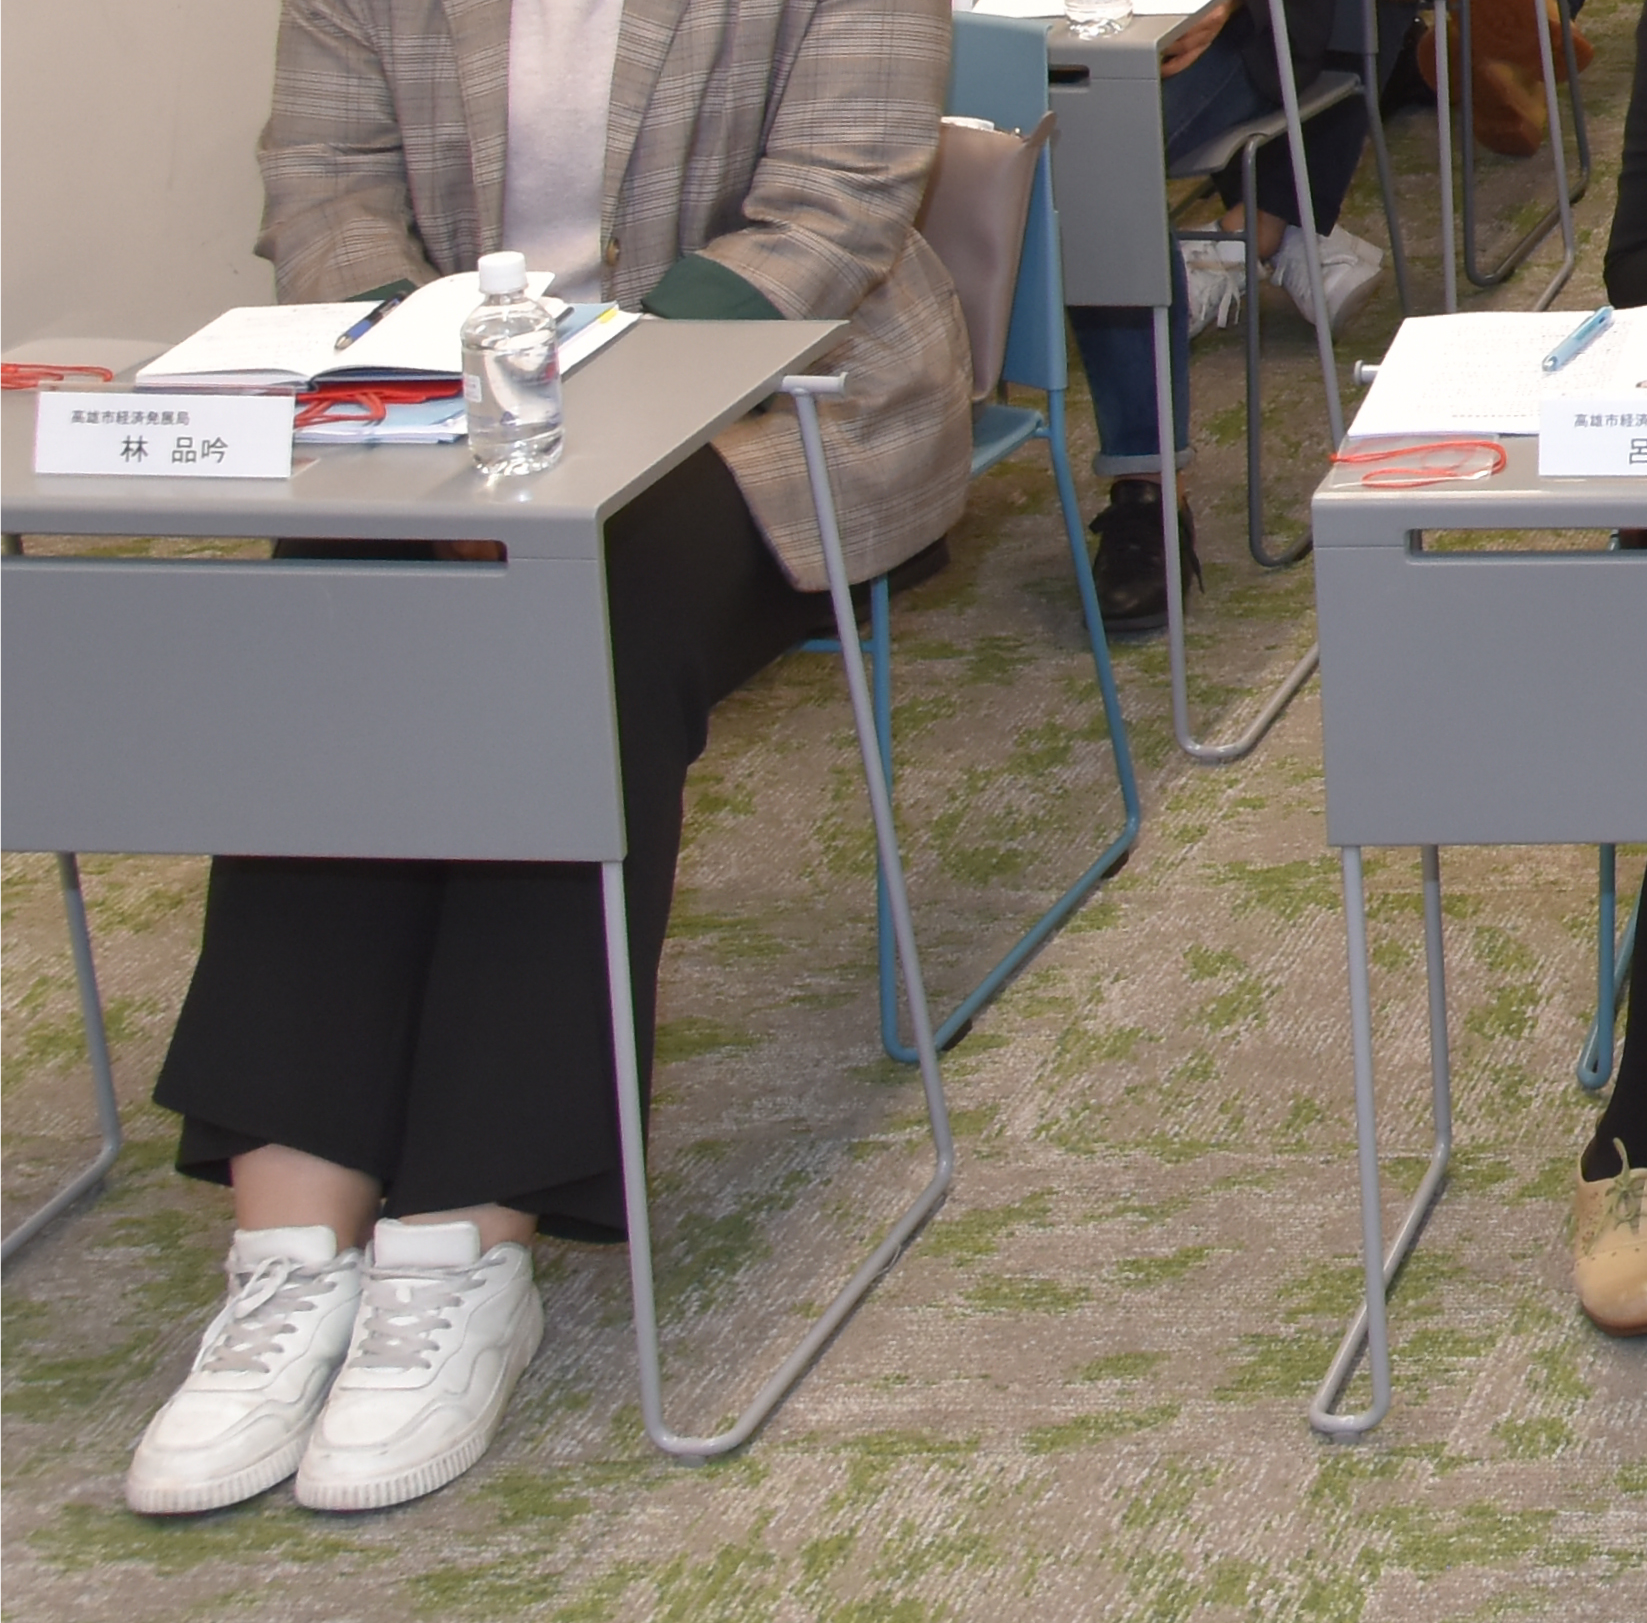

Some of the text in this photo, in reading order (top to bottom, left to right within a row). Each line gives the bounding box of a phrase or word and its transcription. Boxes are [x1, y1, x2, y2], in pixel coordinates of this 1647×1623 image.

[71, 410, 190, 426] 高雄市経済発展局
[120, 435, 229, 464] 林 品吟
